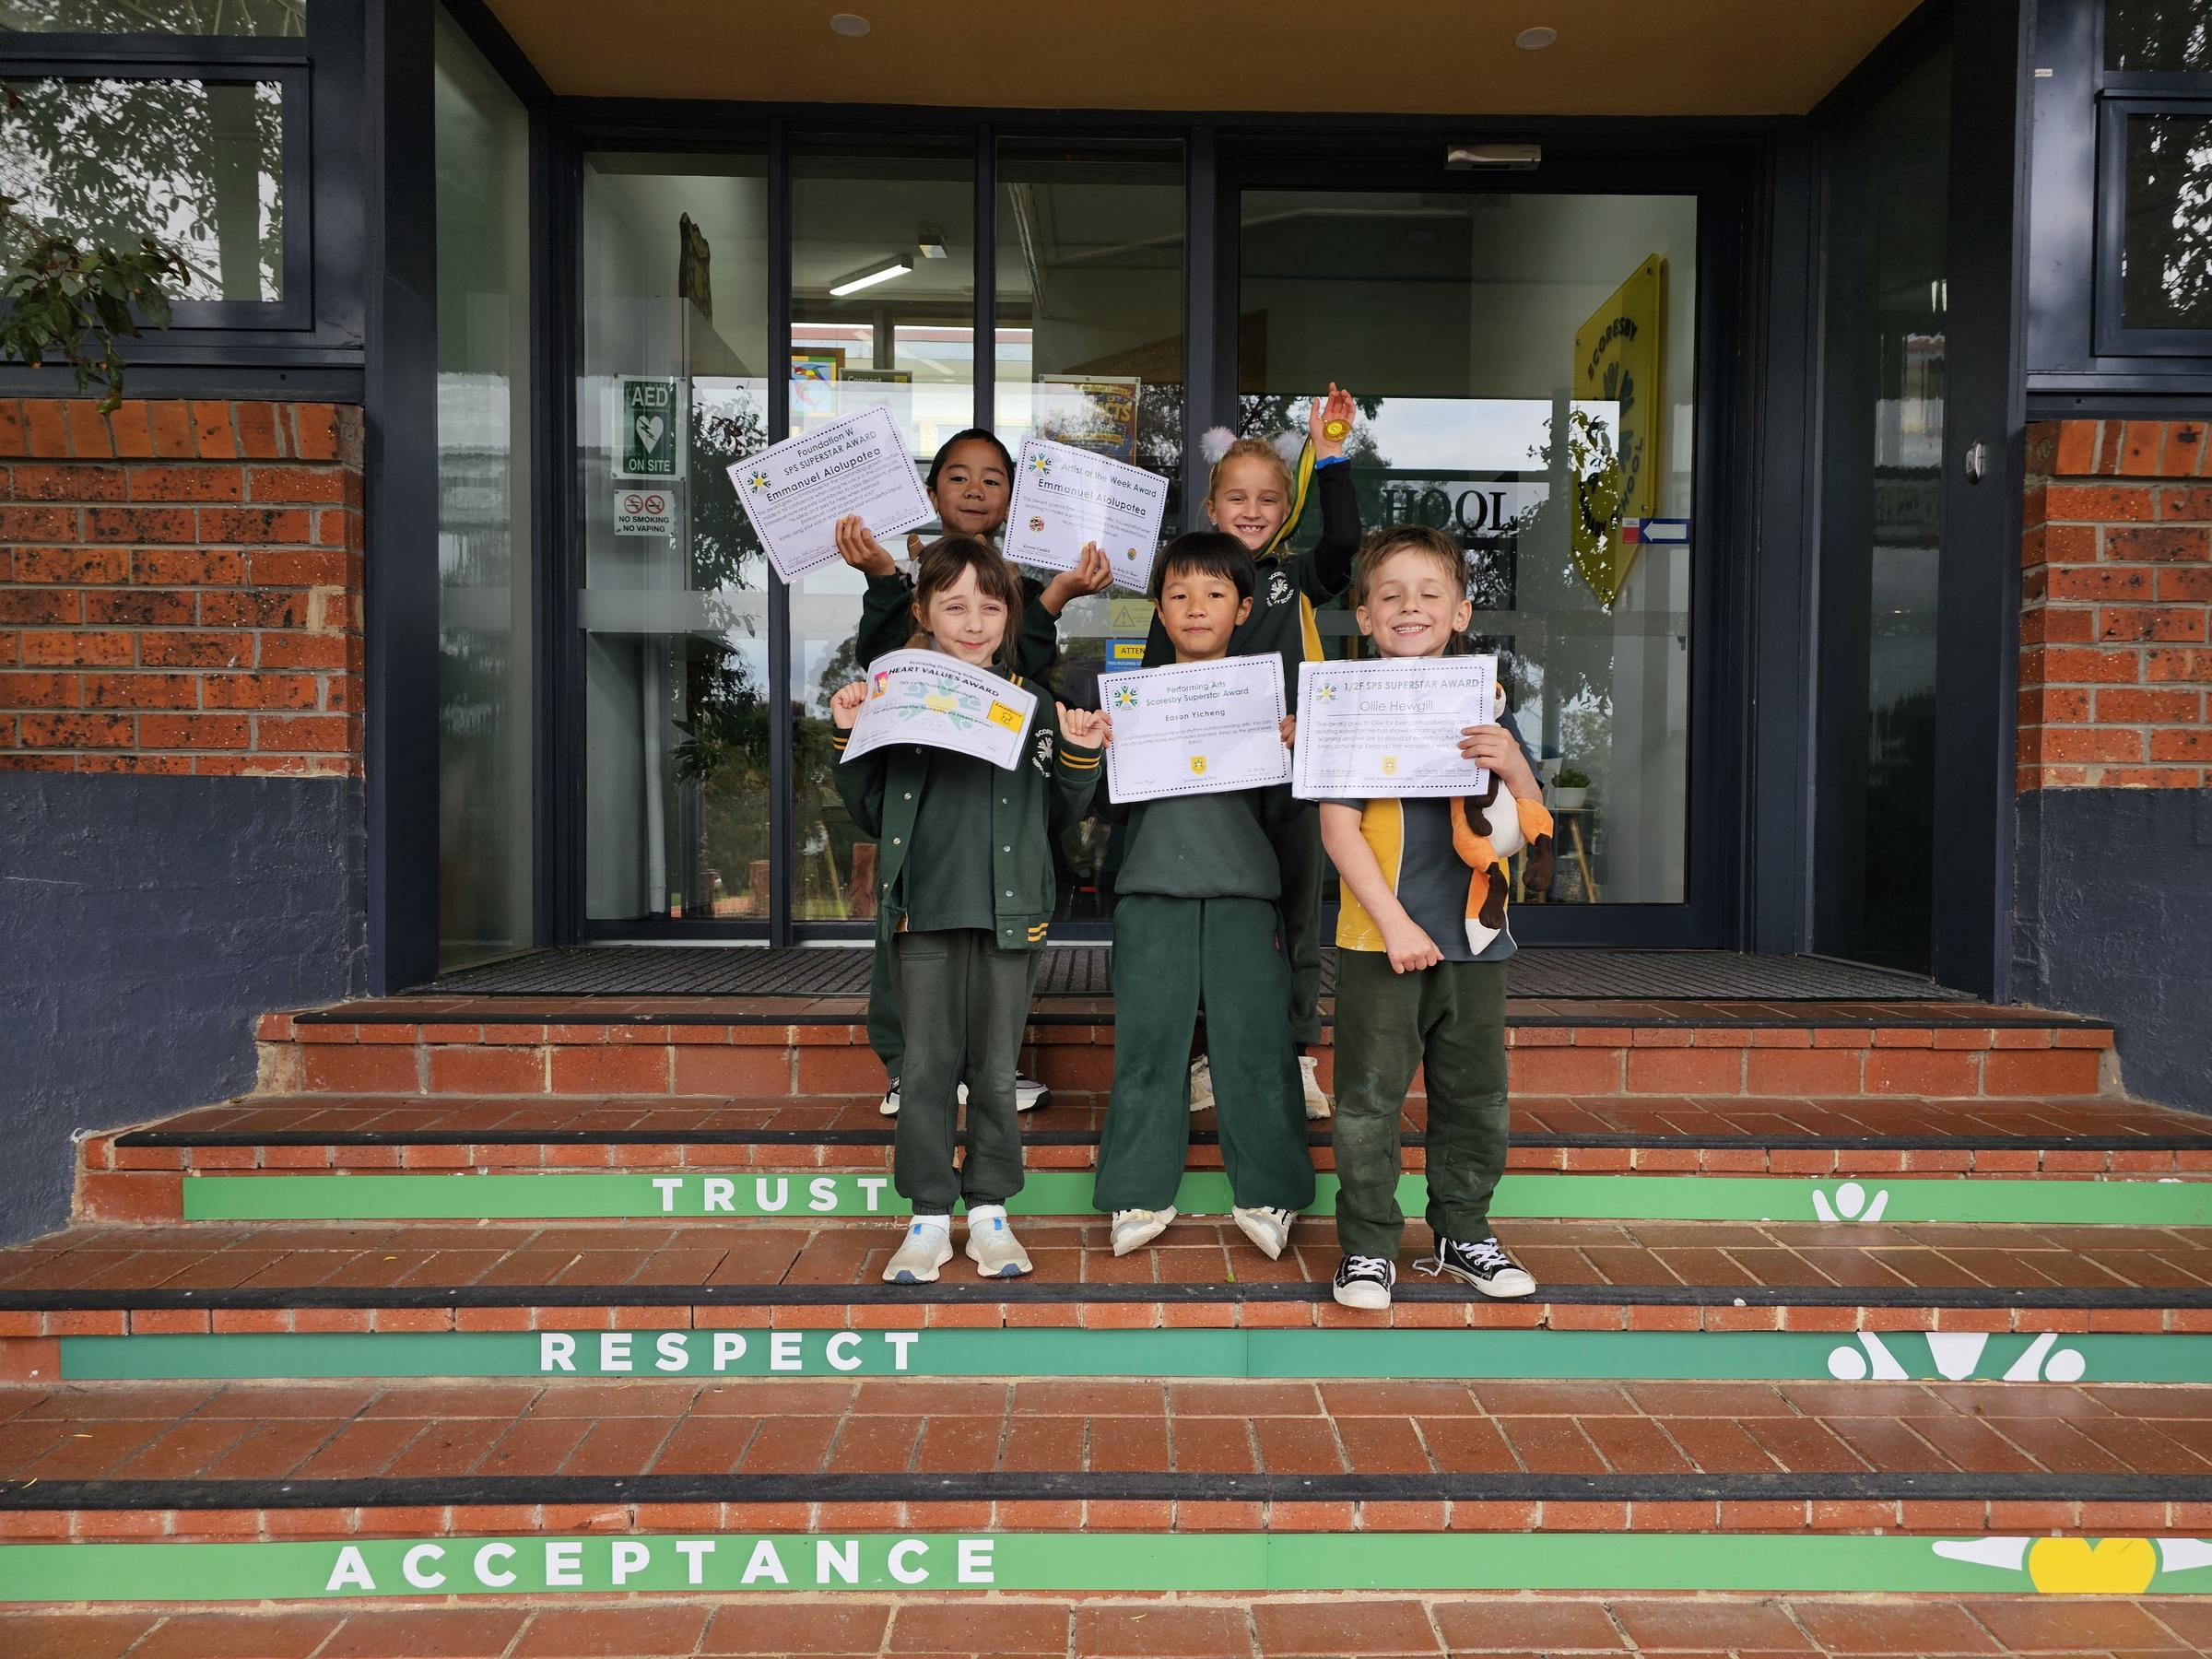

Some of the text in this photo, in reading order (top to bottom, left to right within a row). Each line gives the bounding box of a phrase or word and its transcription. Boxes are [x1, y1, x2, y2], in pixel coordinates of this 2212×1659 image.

[1588, 316, 1638, 380] SCORESBY
[631, 386, 668, 406] AED
[783, 430, 877, 476] SPS SUPERSTAR AWARD
[797, 428, 853, 457] Foundation W
[629, 459, 671, 472] ON SITE
[1061, 463, 1157, 497] Artist of the Week Award
[767, 472, 820, 501] Emmanuel
[1038, 478, 1093, 499] Emmanuel
[888, 666, 920, 676] HEART
[923, 668, 959, 681] VALUES
[963, 678, 999, 696] AWARD
[1166, 683, 1209, 694] Performing
[1344, 679, 1479, 692] 1/2F SPS SUPERSTAR AWARD
[1147, 688, 1249, 707] Scoresby Superstar Award
[1359, 700, 1433, 713] Ollie Hewgill
[1166, 710, 1226, 722] Eason Yicheng
[653, 1177, 888, 1212] TRUST
[540, 1332, 919, 1371] RESPECT
[325, 1539, 995, 1591] ACCEPTANCE
